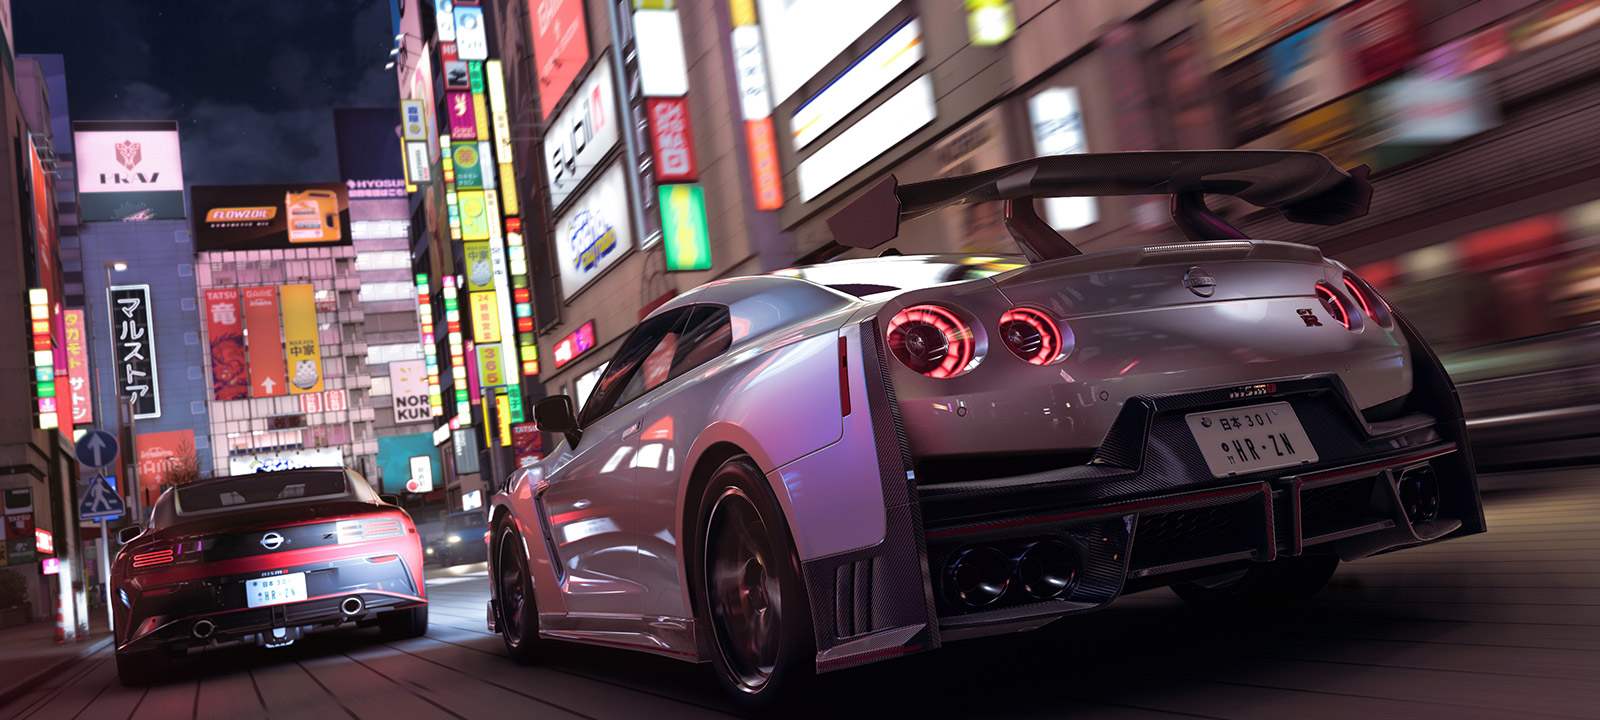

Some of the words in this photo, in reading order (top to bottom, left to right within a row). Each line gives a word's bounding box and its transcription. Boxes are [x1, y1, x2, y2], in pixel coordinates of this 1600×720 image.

[212, 209, 268, 219] FLOWZOIL
[207, 291, 237, 300] TATSU
[246, 289, 272, 297] GAME
[65, 313, 82, 369] タカモト
[117, 298, 149, 404] マルストア
[290, 344, 315, 357] 中家
[484, 348, 498, 383] 365
[69, 376, 87, 420] サトシ
[397, 406, 430, 420] KUN
[1219, 416, 1242, 431] 日本
[1245, 412, 1272, 427] 301
[8, 514, 30, 522] TATSU
